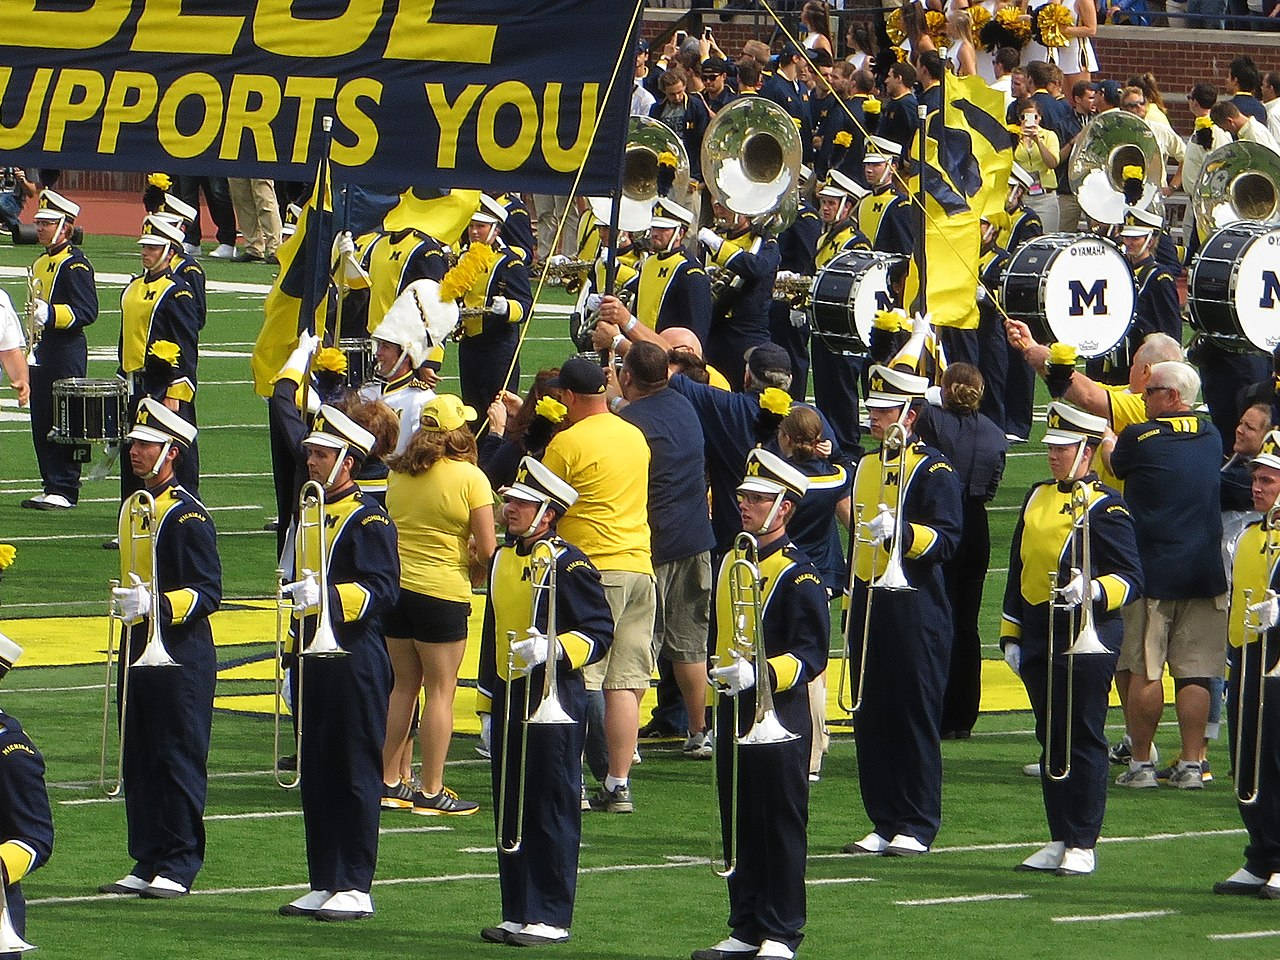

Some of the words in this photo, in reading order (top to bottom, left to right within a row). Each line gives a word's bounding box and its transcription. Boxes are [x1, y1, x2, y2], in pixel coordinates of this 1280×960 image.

[425, 80, 600, 173] YOU
[1078, 245, 1106, 256] YAMAHA
[1068, 279, 1108, 316] M
